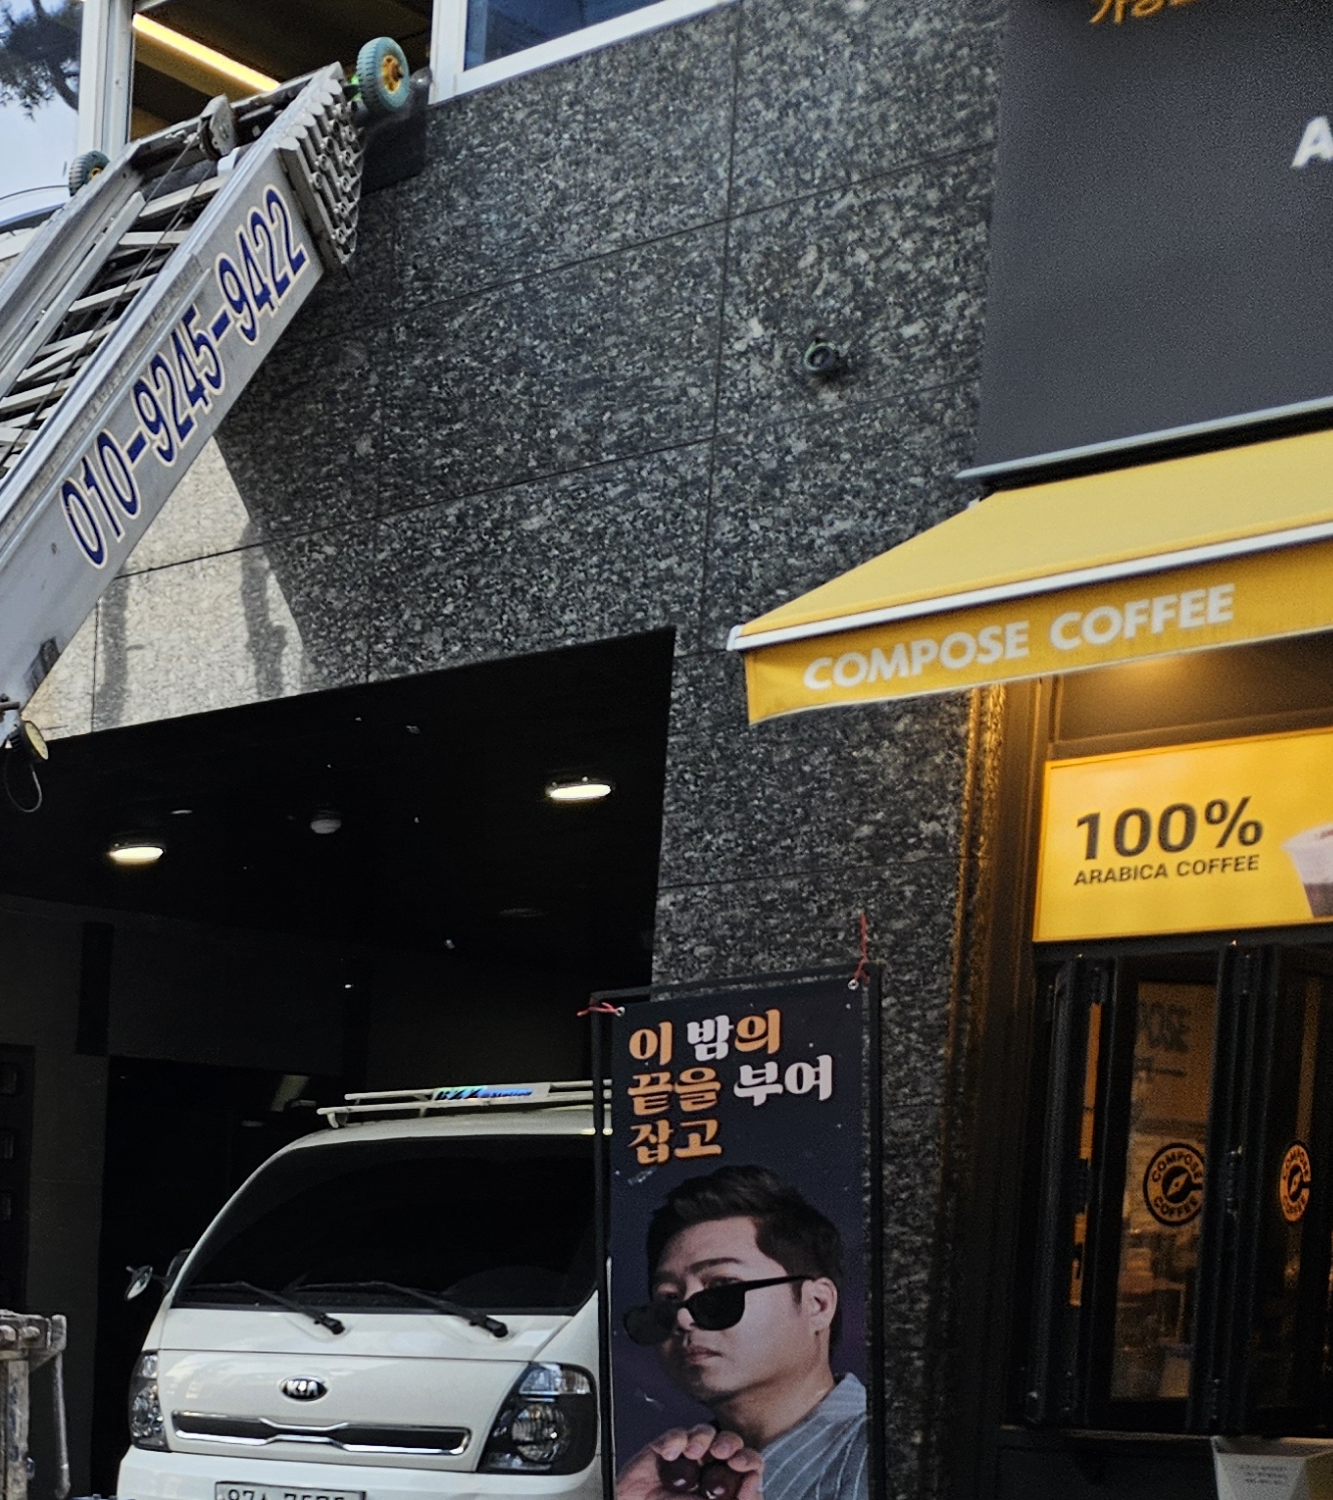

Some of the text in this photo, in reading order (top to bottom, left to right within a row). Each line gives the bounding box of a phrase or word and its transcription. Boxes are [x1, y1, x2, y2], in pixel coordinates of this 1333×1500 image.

[59, 183, 310, 570] 010-9245-9422
[803, 583, 1235, 690] COMPOSE COFFEE
[1075, 797, 1264, 862] 100%
[1074, 854, 1261, 886] ARABICA COFFEE
[629, 1008, 781, 1066] 이 밤의
[627, 1054, 833, 1116] 끝을 부여
[628, 1119, 722, 1165] 잡고
[1151, 1151, 1204, 1183] COMPOSE
[1153, 1195, 1199, 1217] COFFEE
[287, 1380, 318, 1396] KIA
